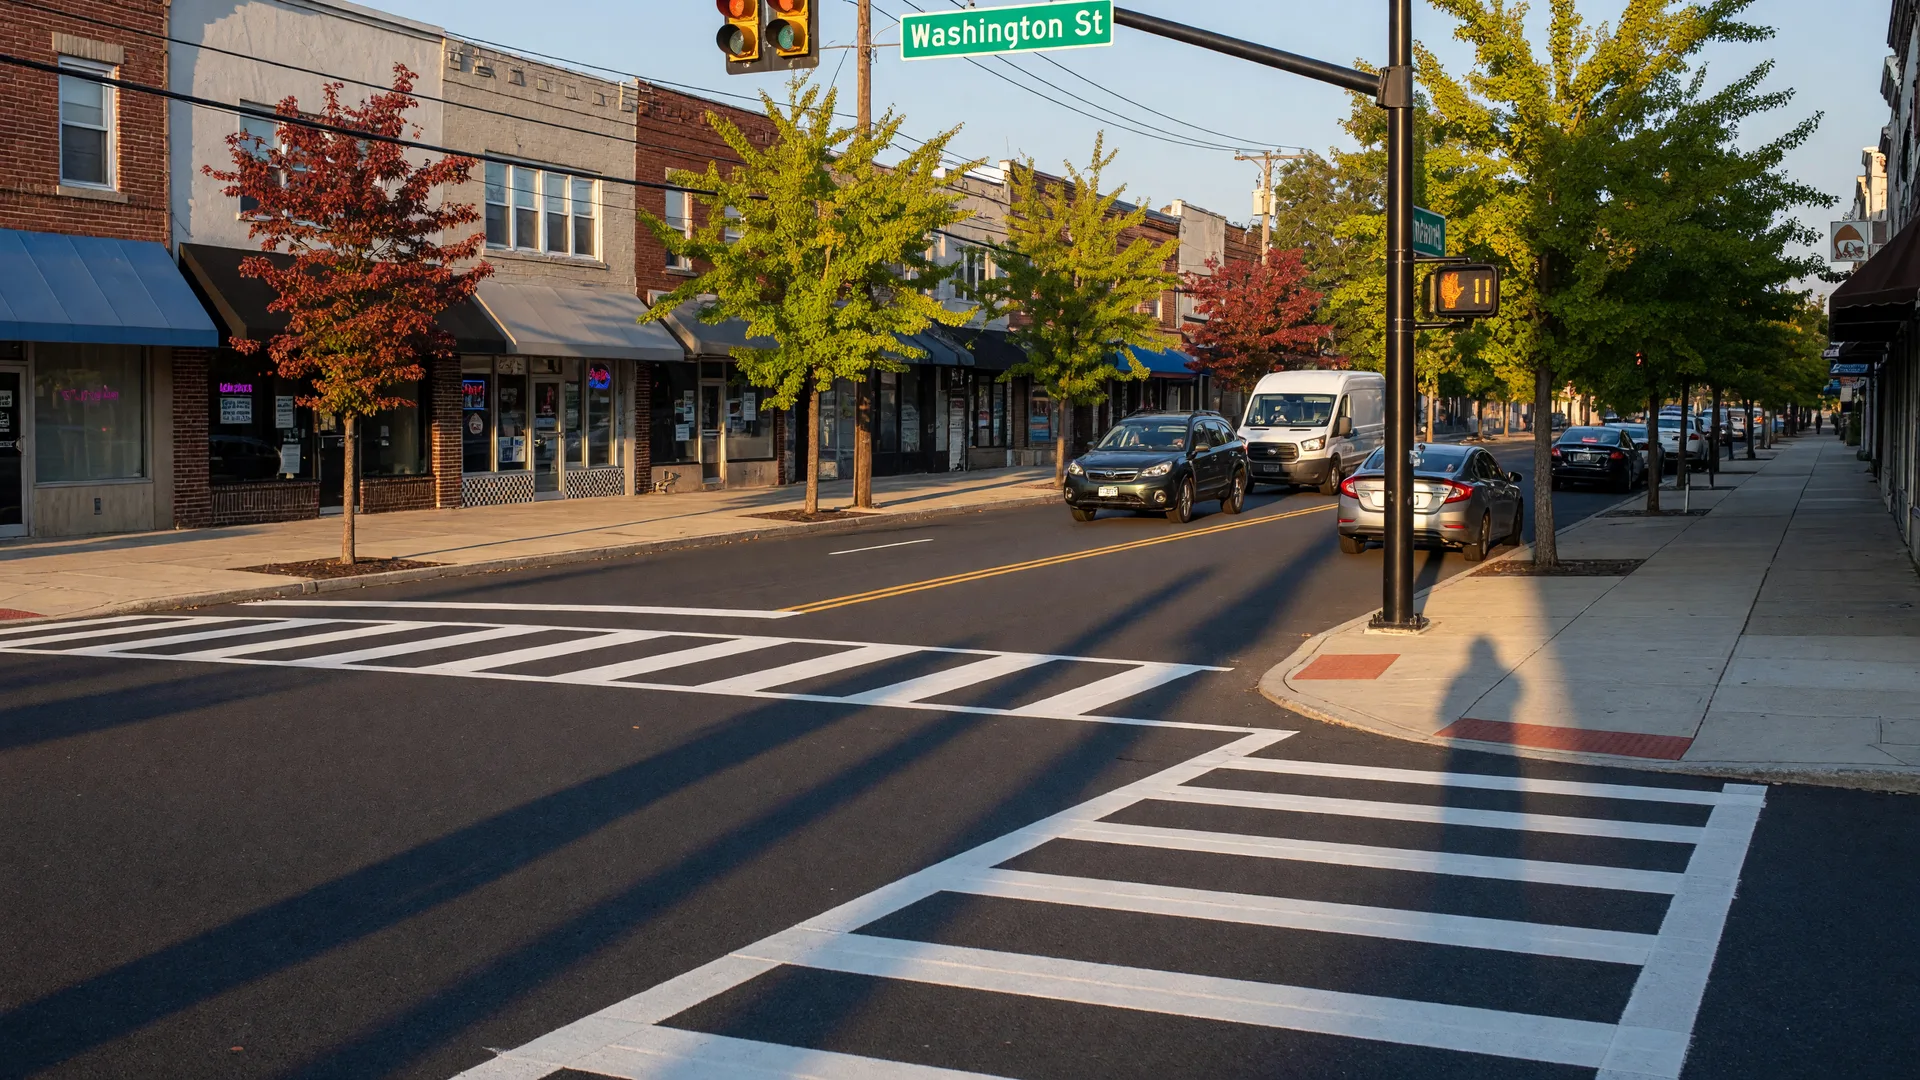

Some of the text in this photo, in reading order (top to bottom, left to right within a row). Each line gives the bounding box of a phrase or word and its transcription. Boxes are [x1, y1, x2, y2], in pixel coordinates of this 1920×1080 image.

[911, 9, 1103, 49] Washington St
[1474, 278, 1490, 304] 11
